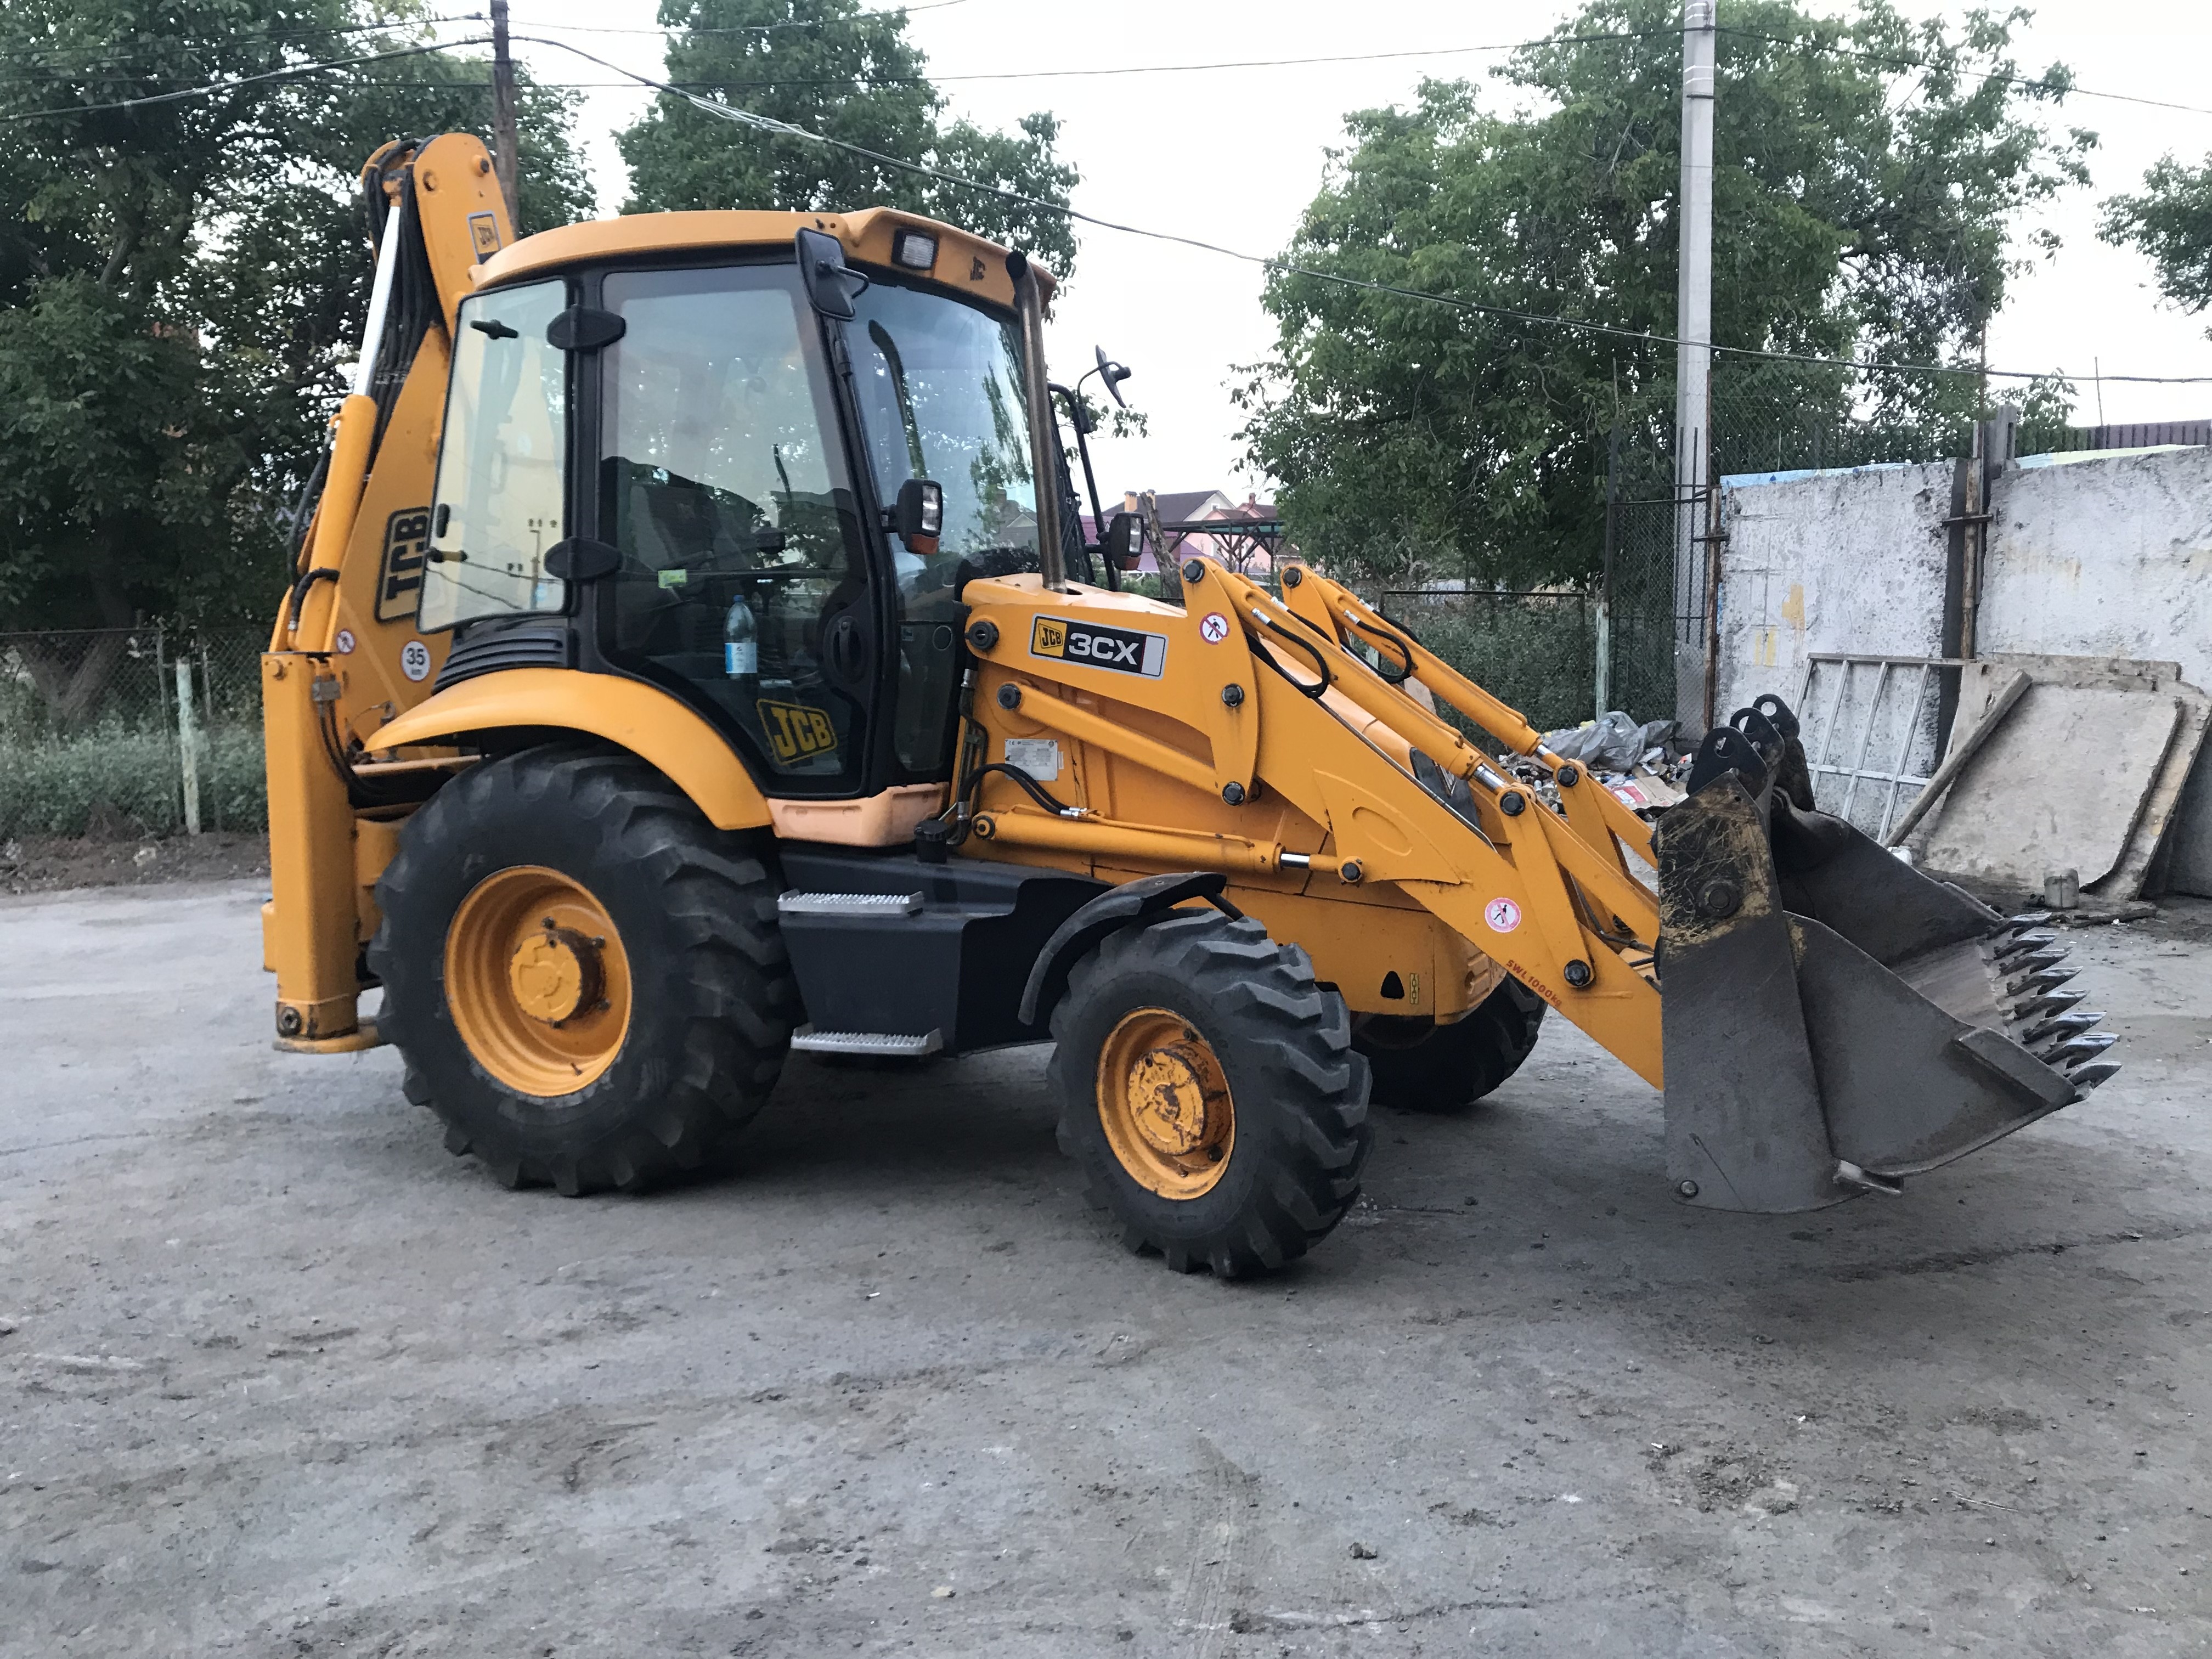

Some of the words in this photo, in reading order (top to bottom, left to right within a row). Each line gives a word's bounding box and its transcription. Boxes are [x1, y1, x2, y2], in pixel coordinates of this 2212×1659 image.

[407, 647, 426, 665] 35
[1041, 627, 1062, 646] JCB
[1069, 633, 1139, 665] 3CX
[771, 707, 831, 757] JCB
[1506, 959, 1527, 979] SWL
